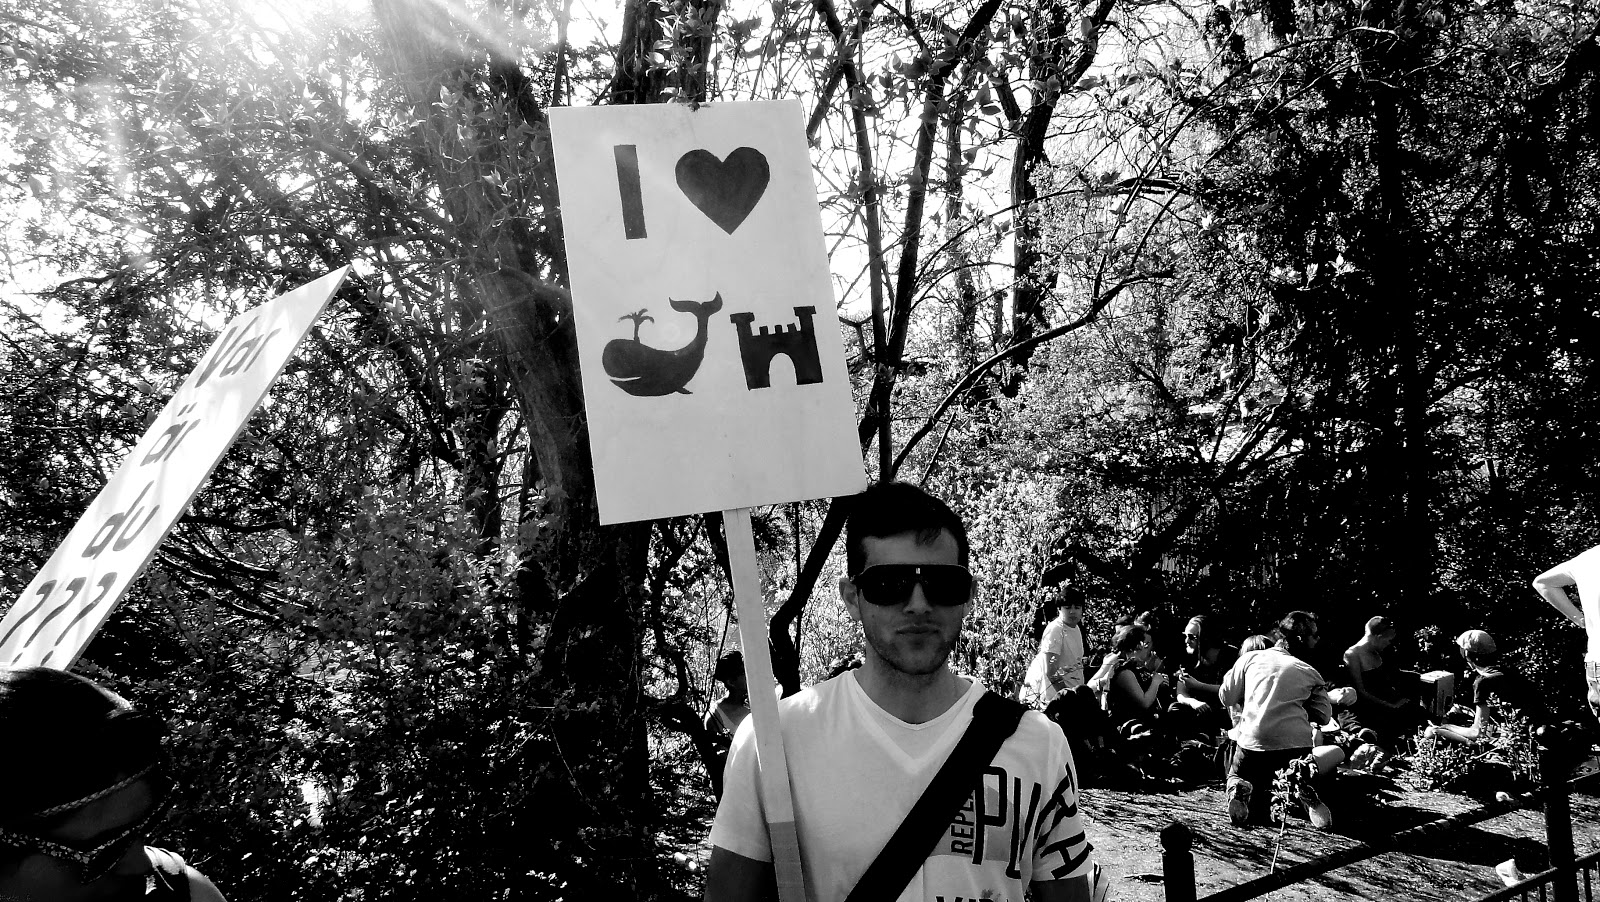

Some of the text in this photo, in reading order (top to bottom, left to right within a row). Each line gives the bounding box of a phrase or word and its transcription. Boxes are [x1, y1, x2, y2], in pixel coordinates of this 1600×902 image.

[613, 144, 648, 240] I
[195, 315, 281, 388] Var
[139, 402, 201, 467] är
[81, 480, 160, 559] du
